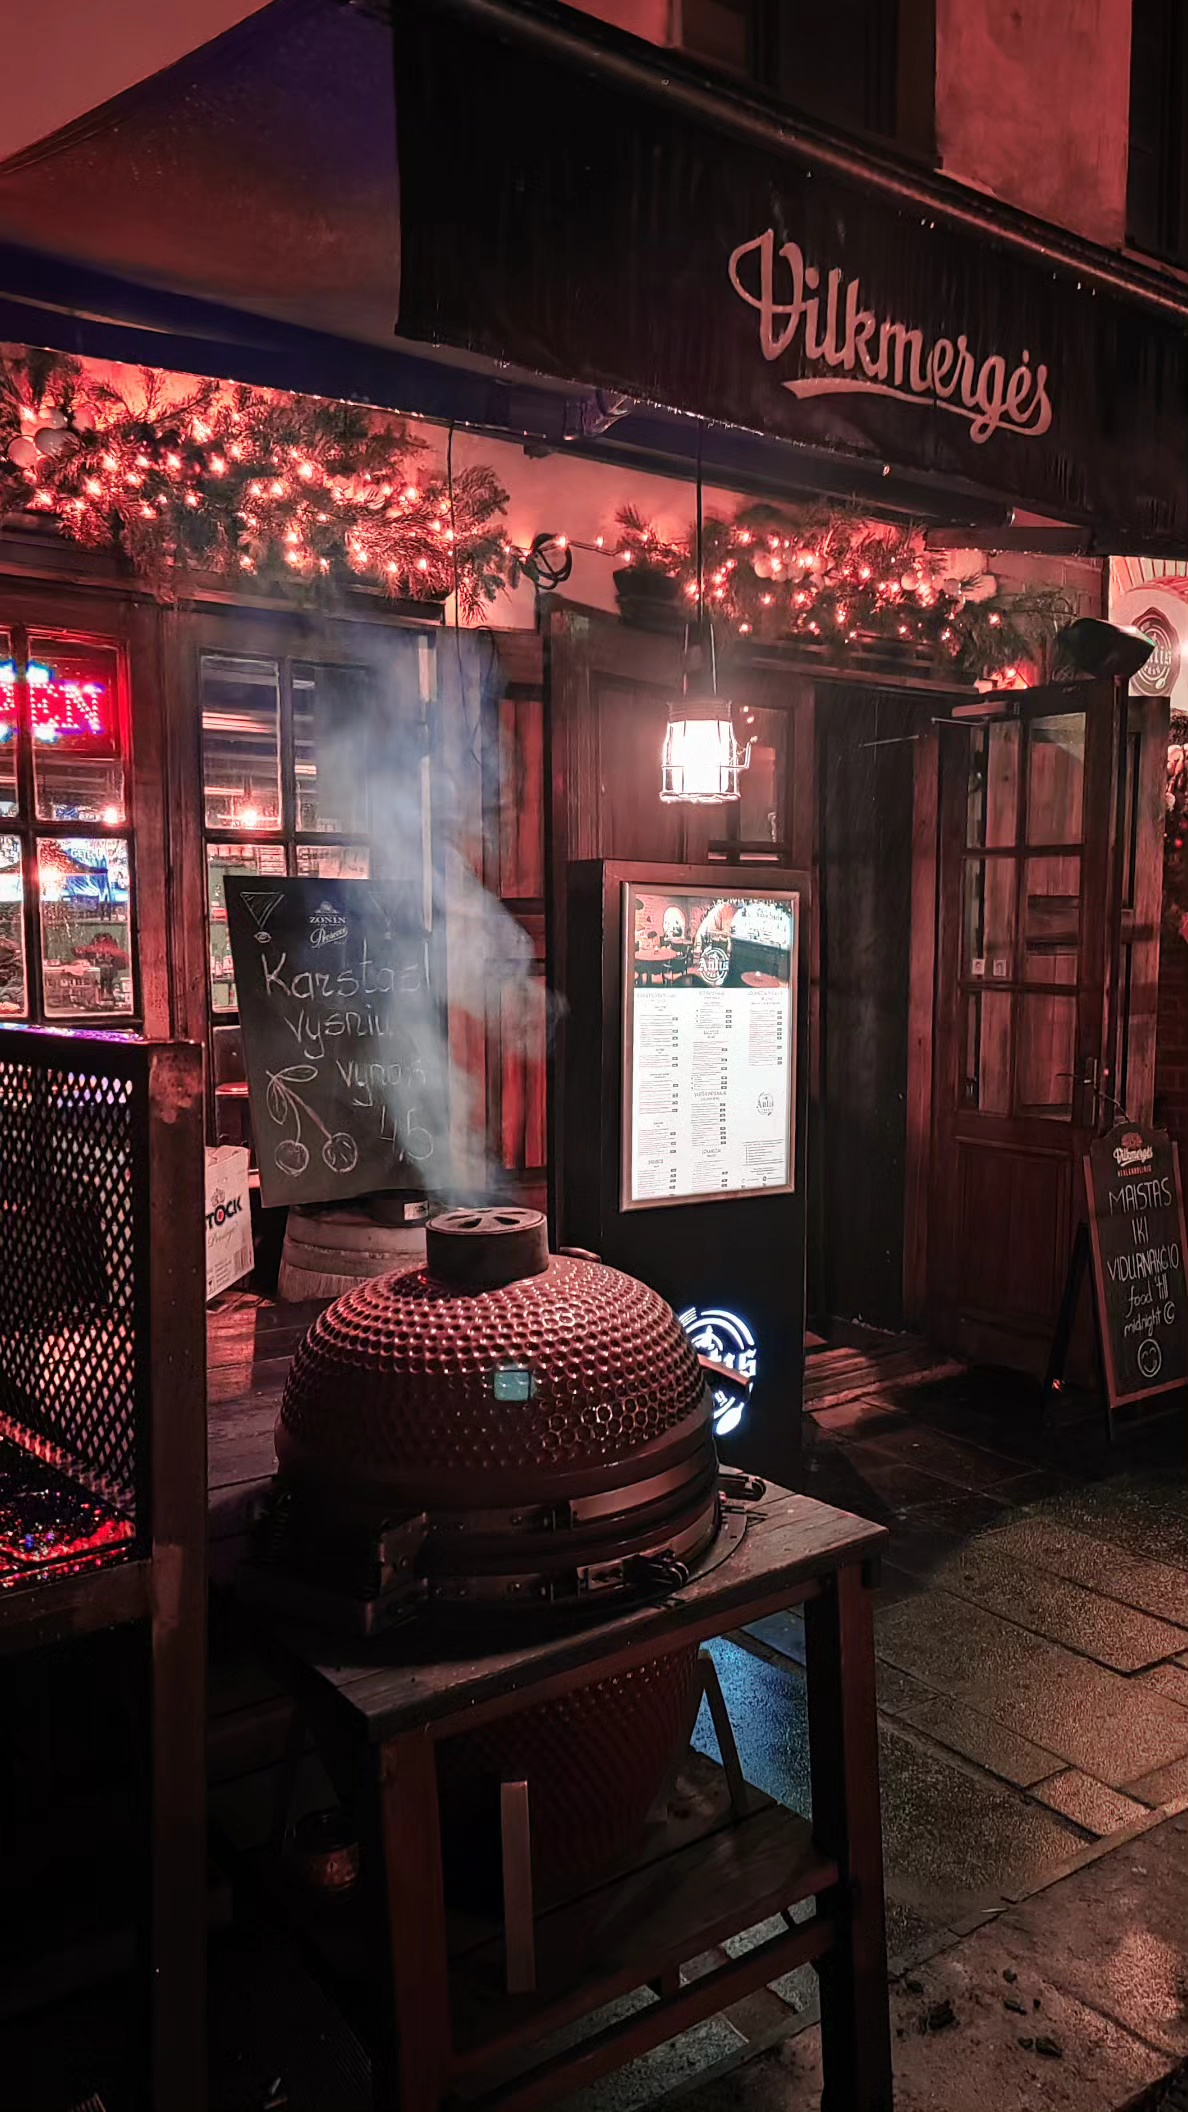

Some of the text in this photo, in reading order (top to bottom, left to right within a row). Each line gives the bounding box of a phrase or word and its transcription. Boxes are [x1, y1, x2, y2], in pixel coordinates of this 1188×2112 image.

[728, 228, 1052, 444] Vilkmergės
[309, 916, 346, 924] ZONIN
[205, 1196, 243, 1230] TOCK
[1108, 1177, 1172, 1216] MAISTAS
[1132, 1216, 1149, 1245] IKI
[1126, 1280, 1153, 1318] food
[1124, 1306, 1162, 1337] midnight
